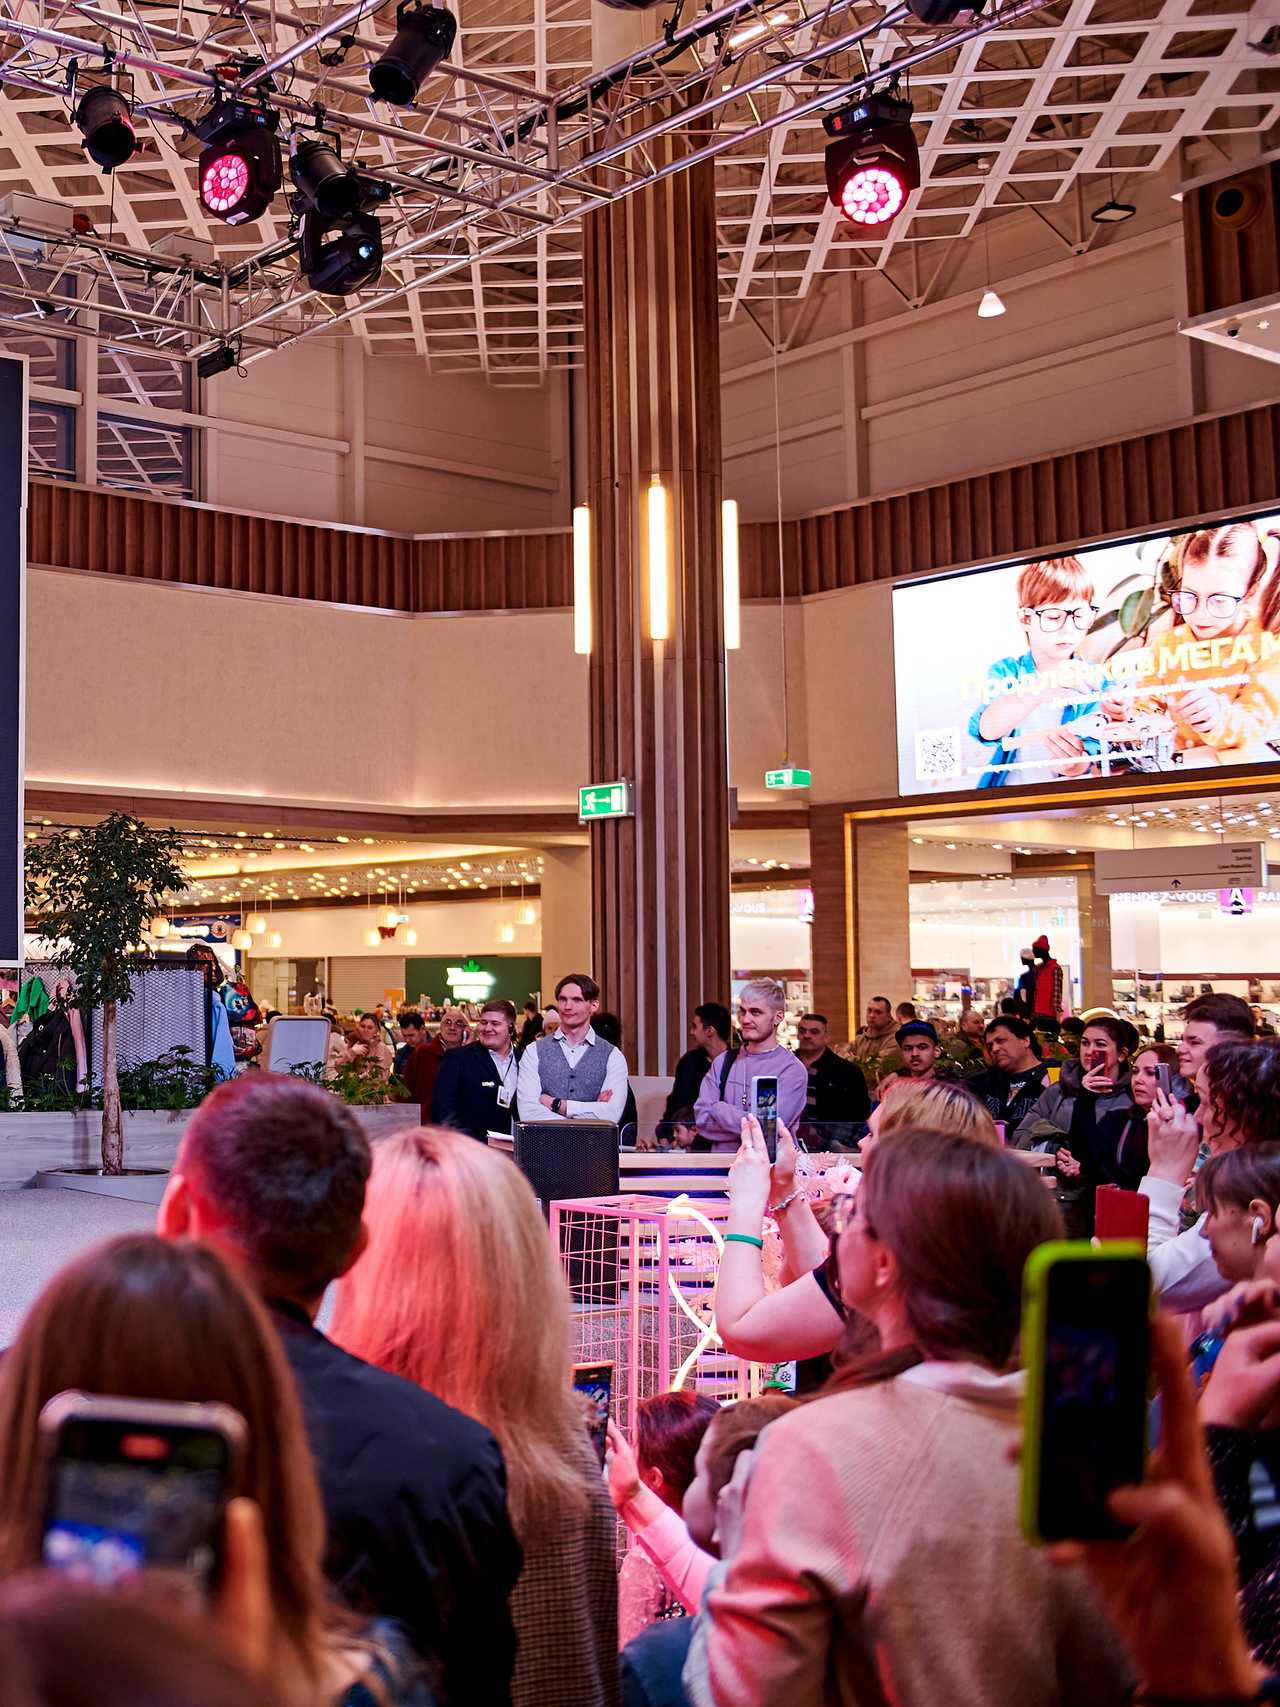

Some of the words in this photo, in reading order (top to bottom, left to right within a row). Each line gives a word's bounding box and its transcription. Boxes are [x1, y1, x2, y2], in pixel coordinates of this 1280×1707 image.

[961, 657, 1131, 706] Продлёнка
[1133, 654, 1157, 677] в
[1158, 633, 1258, 675] МЕГА
